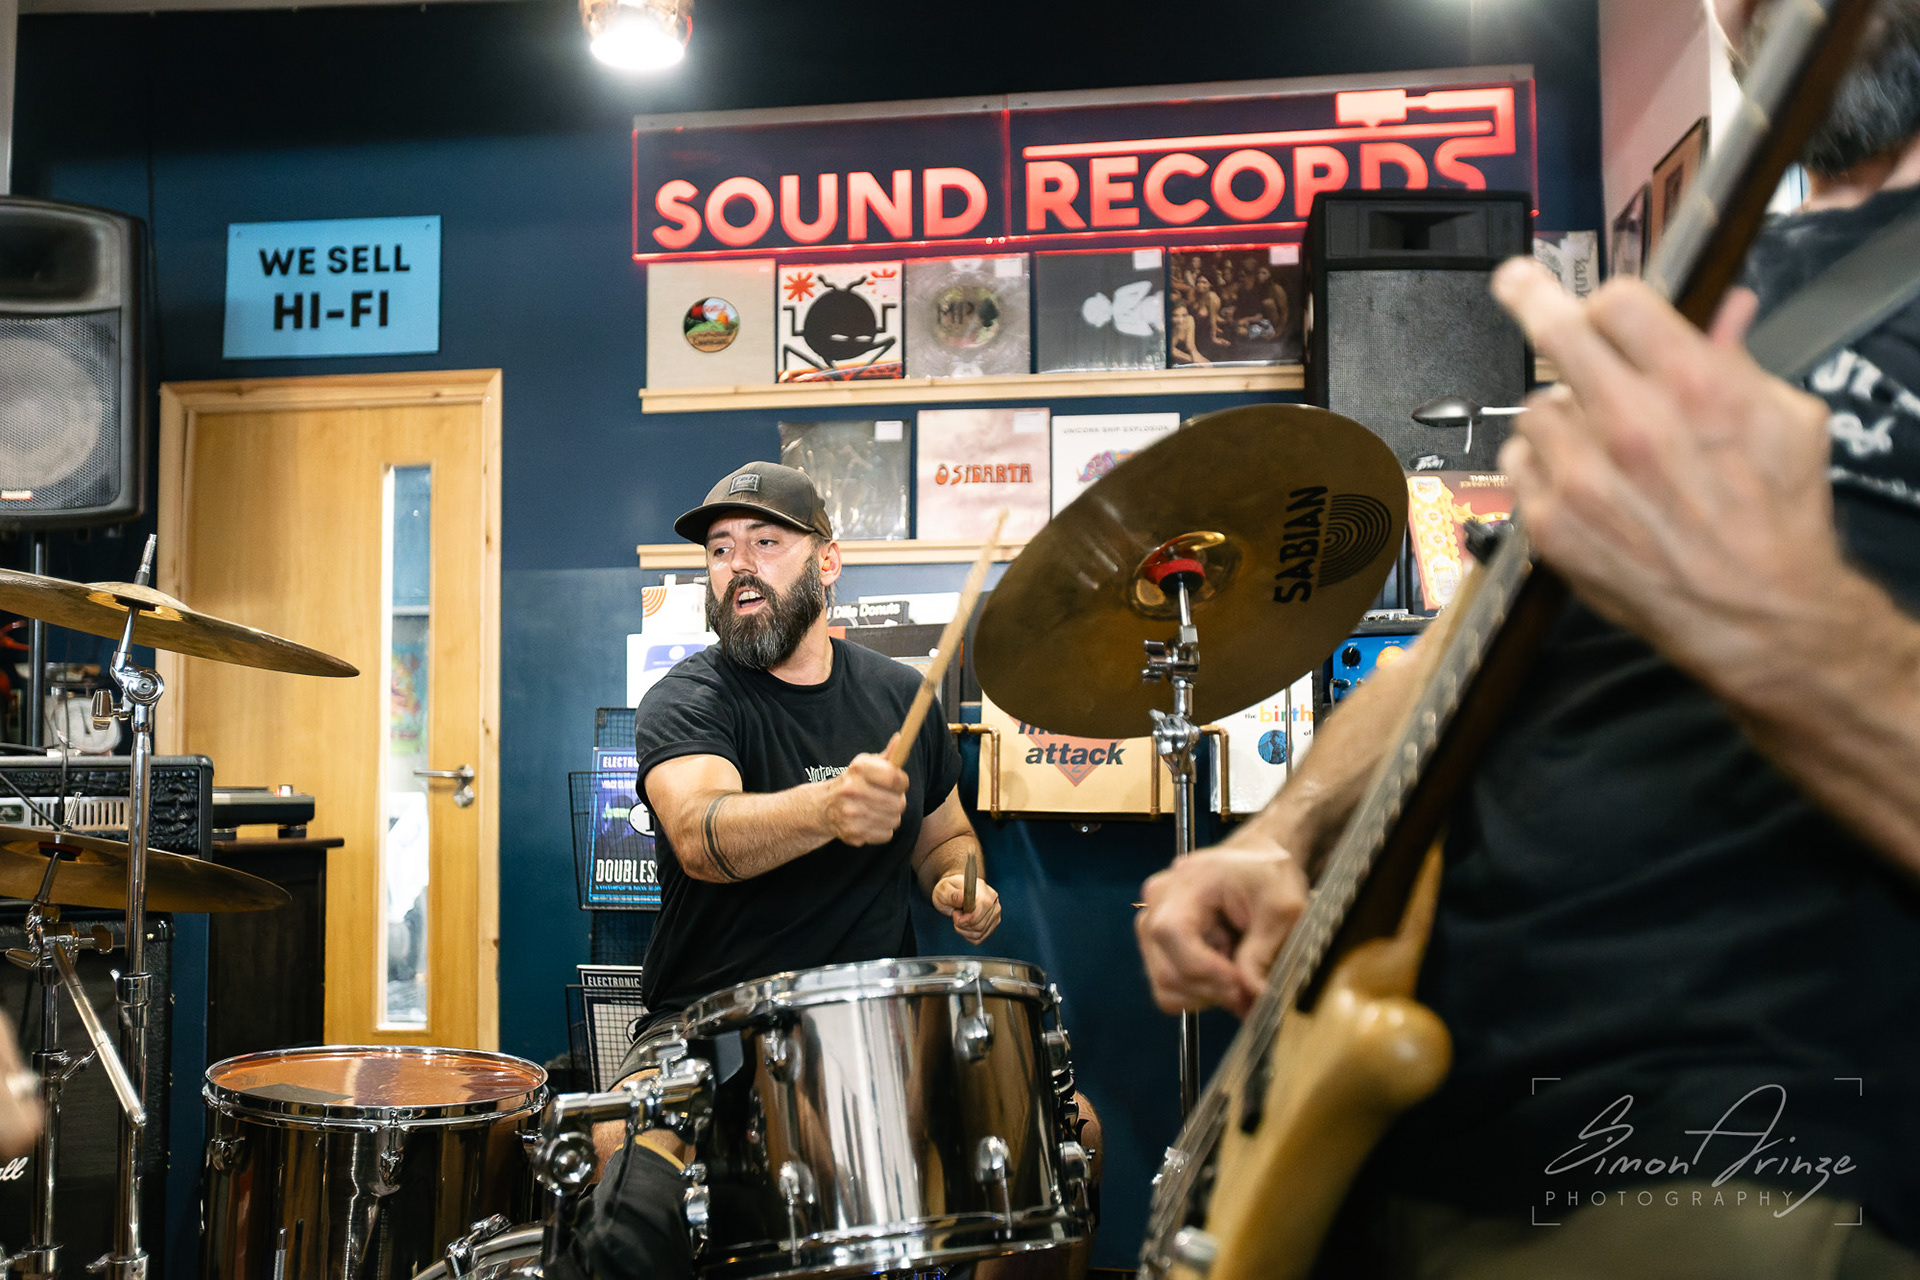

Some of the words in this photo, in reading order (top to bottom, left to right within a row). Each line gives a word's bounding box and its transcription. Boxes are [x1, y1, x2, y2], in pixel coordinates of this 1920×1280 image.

[652, 167, 988, 249] SOUND
[1025, 136, 1516, 231] RECORDS
[259, 248, 316, 276] WE
[327, 244, 411, 274] SELL
[273, 289, 389, 330] HI-FI
[1272, 486, 1328, 603] SABIAN
[1245, 712, 1257, 720] the
[1260, 704, 1314, 722] birth
[1303, 729, 1312, 737] of
[1025, 743, 1127, 766] attack
[595, 858, 660, 884] DOUBLES
